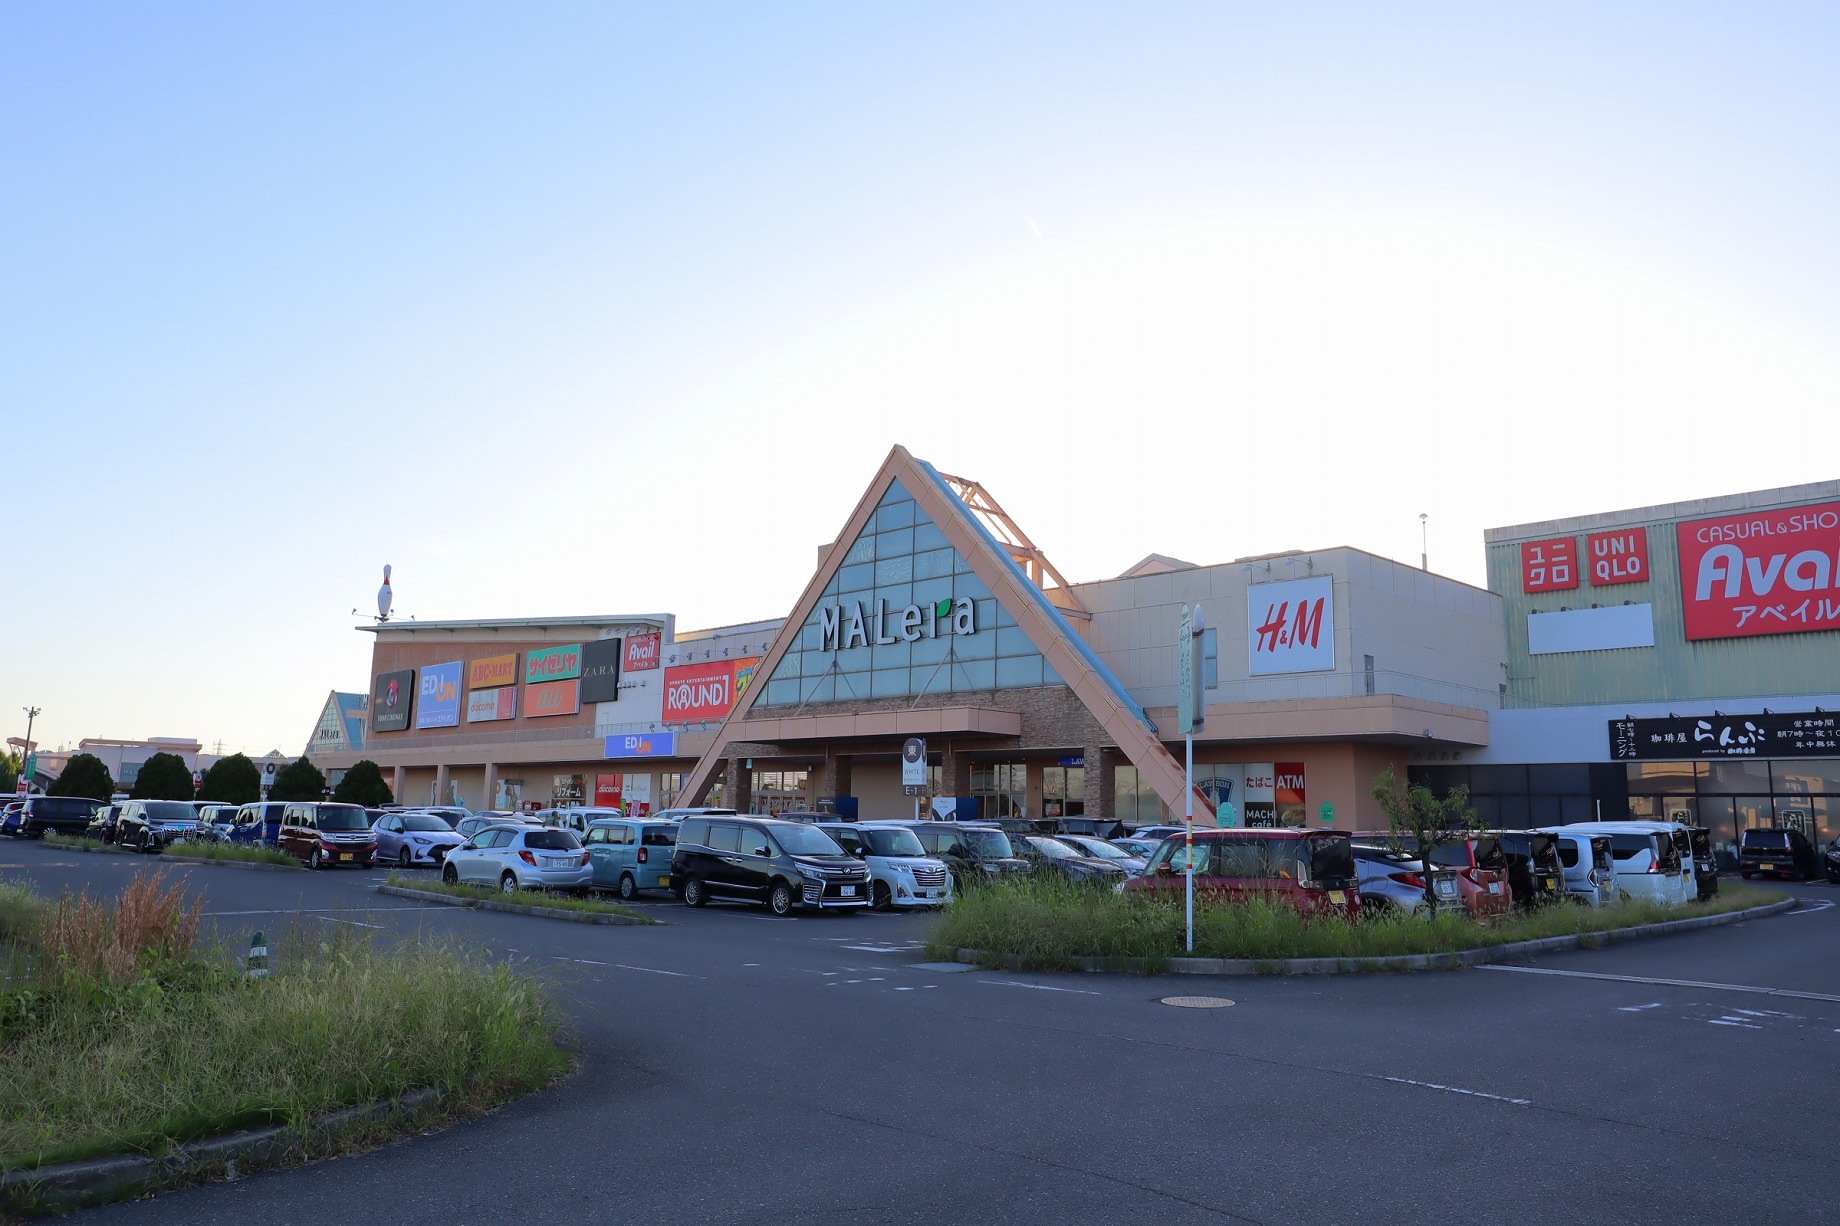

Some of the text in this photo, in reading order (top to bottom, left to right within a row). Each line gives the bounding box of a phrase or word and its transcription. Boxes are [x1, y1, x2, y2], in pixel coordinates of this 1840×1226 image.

[1594, 535, 1635, 557] UNI
[1596, 556, 1641, 580] QLO
[1732, 598, 1840, 628] アベイル
[819, 595, 977, 652] MALera
[1256, 596, 1325, 653] H&M
[628, 640, 655, 661] Avail
[472, 661, 513, 682] ABC-MART
[529, 652, 577, 677] サイゼリヤ
[583, 664, 615, 677] ZARA
[686, 675, 724, 684] ENTERTAINMENT
[536, 687, 563, 709] au
[667, 674, 730, 711] ROUND1
[470, 701, 495, 713] docomo
[1793, 718, 1835, 728] 営業時間
[1615, 722, 1628, 757] モーニング
[1650, 732, 1688, 743] 珈琲屋
[907, 745, 917, 757] 東
[598, 784, 620, 793] docomo
[1245, 776, 1273, 788] たばこ
[1276, 774, 1304, 790] ATM
[556, 787, 581, 798] リフォーム
[905, 786, 918, 795] E-1
[1251, 819, 1272, 829] café
